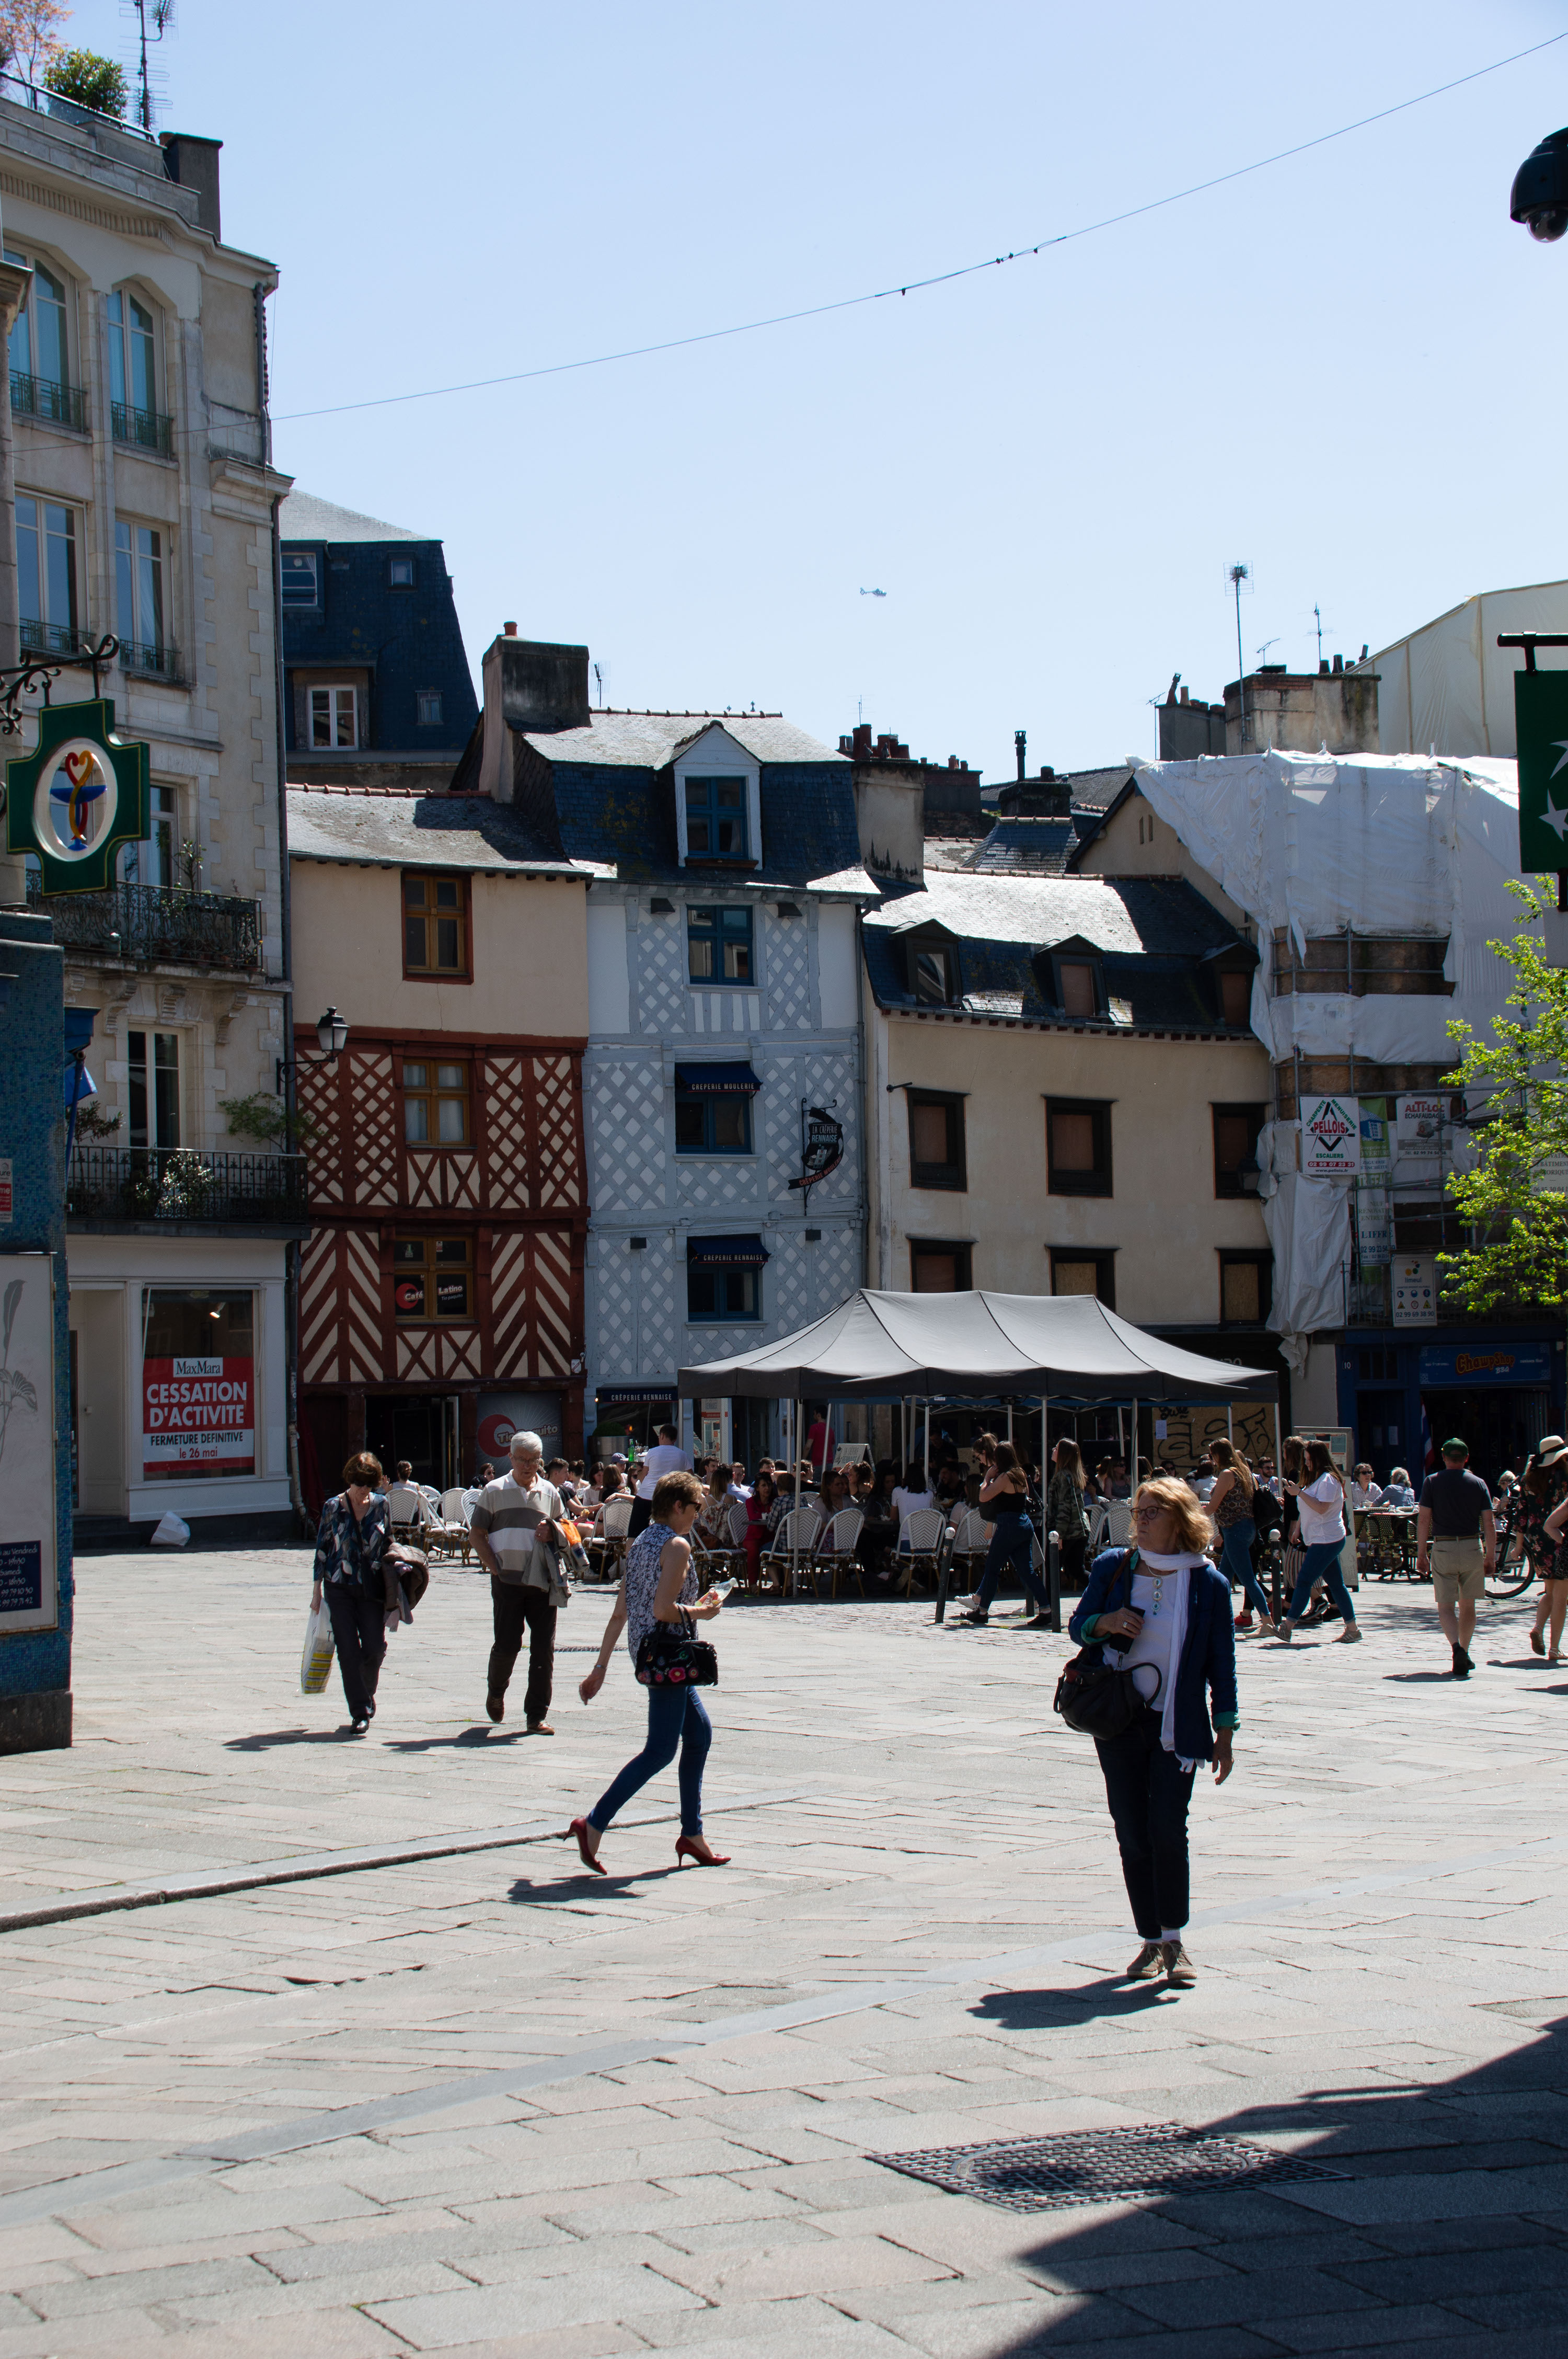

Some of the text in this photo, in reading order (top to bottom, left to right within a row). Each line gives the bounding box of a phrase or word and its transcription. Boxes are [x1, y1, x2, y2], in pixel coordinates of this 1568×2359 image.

[1307, 1100, 1327, 1127] CHARPENTE
[1331, 1098, 1357, 1130] MENUISERIE
[1314, 1120, 1345, 1133] PELLOIS
[405, 1291, 423, 1301] Café
[439, 1286, 463, 1295] Latino
[176, 1359, 221, 1375] MaxMara
[147, 1381, 247, 1404] CESSATION
[149, 1404, 244, 1427] D'ACTIVITE
[151, 1432, 243, 1446] FERMETURE DEFINITIVE
[179, 1446, 218, 1459] le 26 mai
[11, 1543, 38, 1555] Vendredi
[0, 1565, 21, 1576] Samedi
